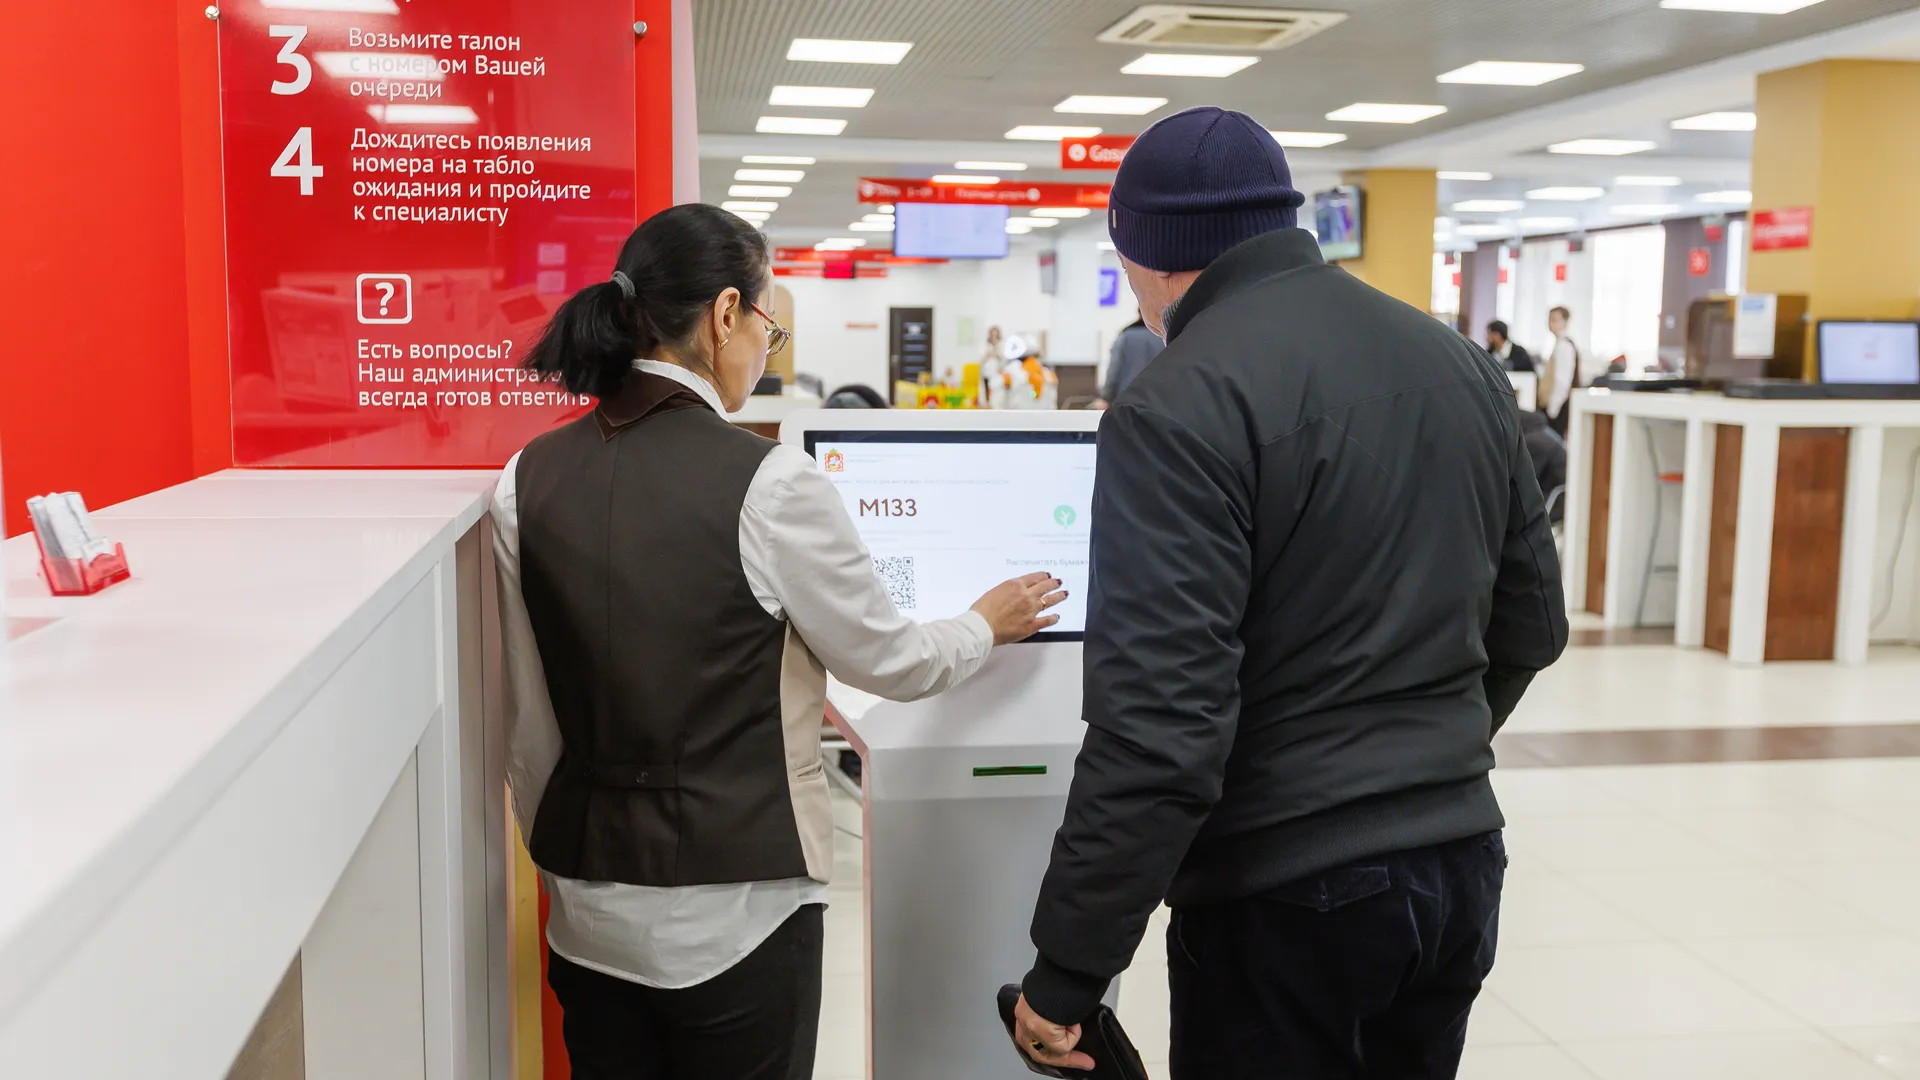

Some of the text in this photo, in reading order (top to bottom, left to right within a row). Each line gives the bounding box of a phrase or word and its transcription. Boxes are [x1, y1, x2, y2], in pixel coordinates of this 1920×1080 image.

[349, 27, 521, 52] Возьмите талон
[268, 25, 313, 95] 3
[368, 56, 467, 77] номером
[475, 55, 546, 76] Вашей
[350, 80, 442, 101] очереди
[351, 128, 592, 152] Дождитесь появления
[270, 127, 324, 195] 4
[352, 155, 535, 177] номера на табло
[353, 179, 592, 203] ожидания и пройдите
[354, 206, 509, 227] к специалисту
[357, 339, 514, 364] Есть вопросы?
[358, 363, 404, 383] Наш
[358, 390, 590, 409] всегда готов ответить
